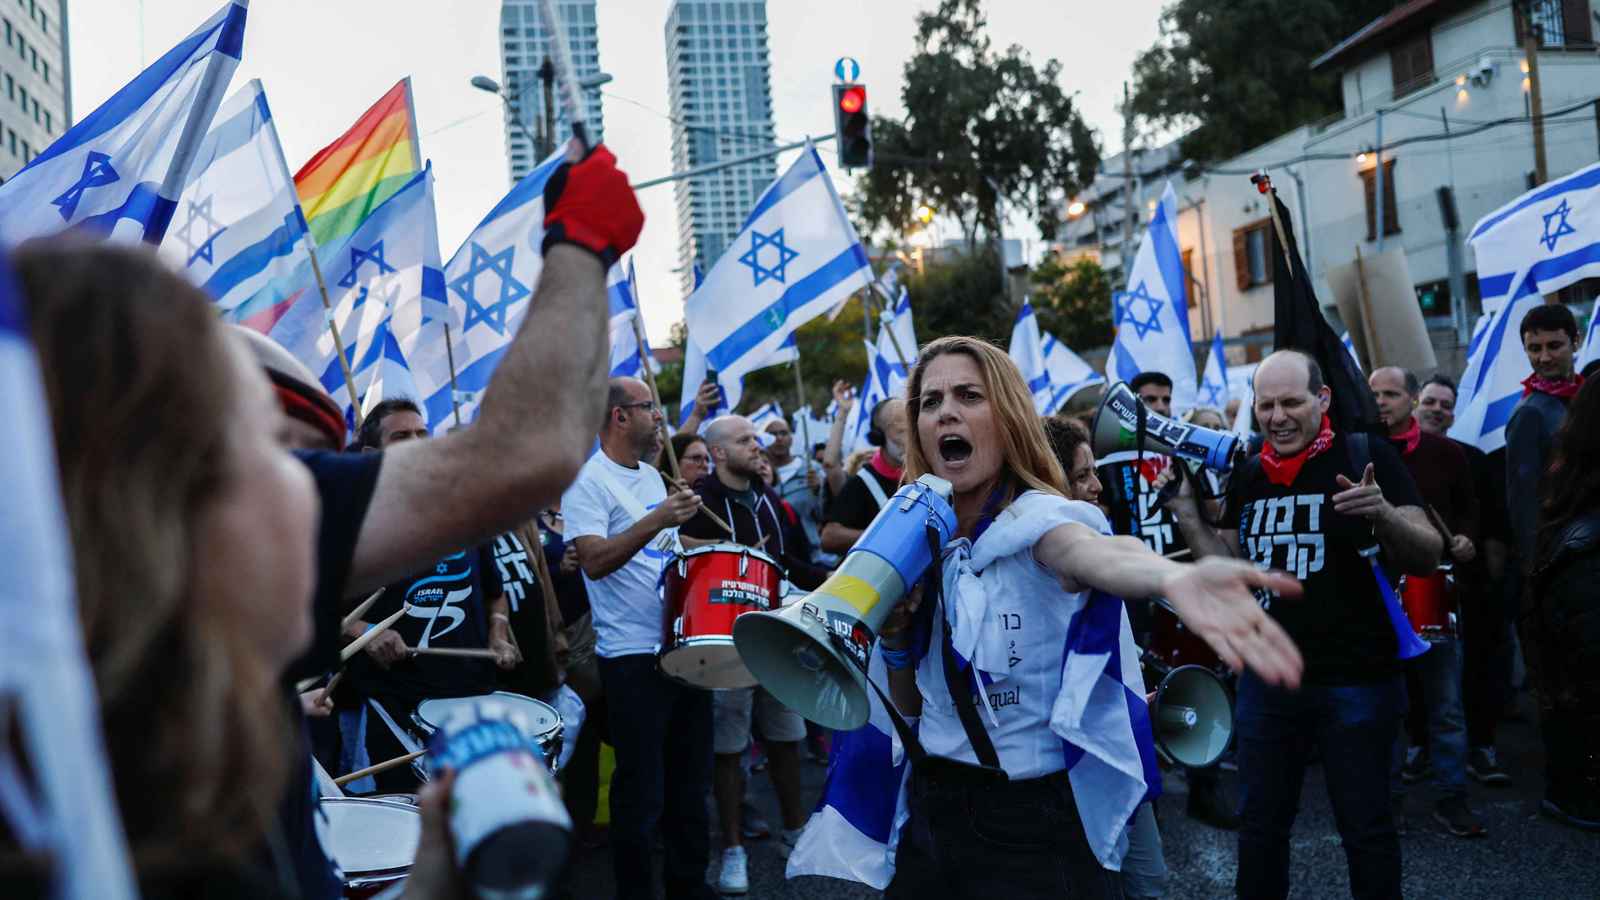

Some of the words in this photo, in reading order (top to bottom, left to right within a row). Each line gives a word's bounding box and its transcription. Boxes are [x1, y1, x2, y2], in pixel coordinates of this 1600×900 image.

[1251, 494, 1324, 534] דמו
[417, 588, 444, 596] ISRAEL
[988, 686, 1020, 711] qual
